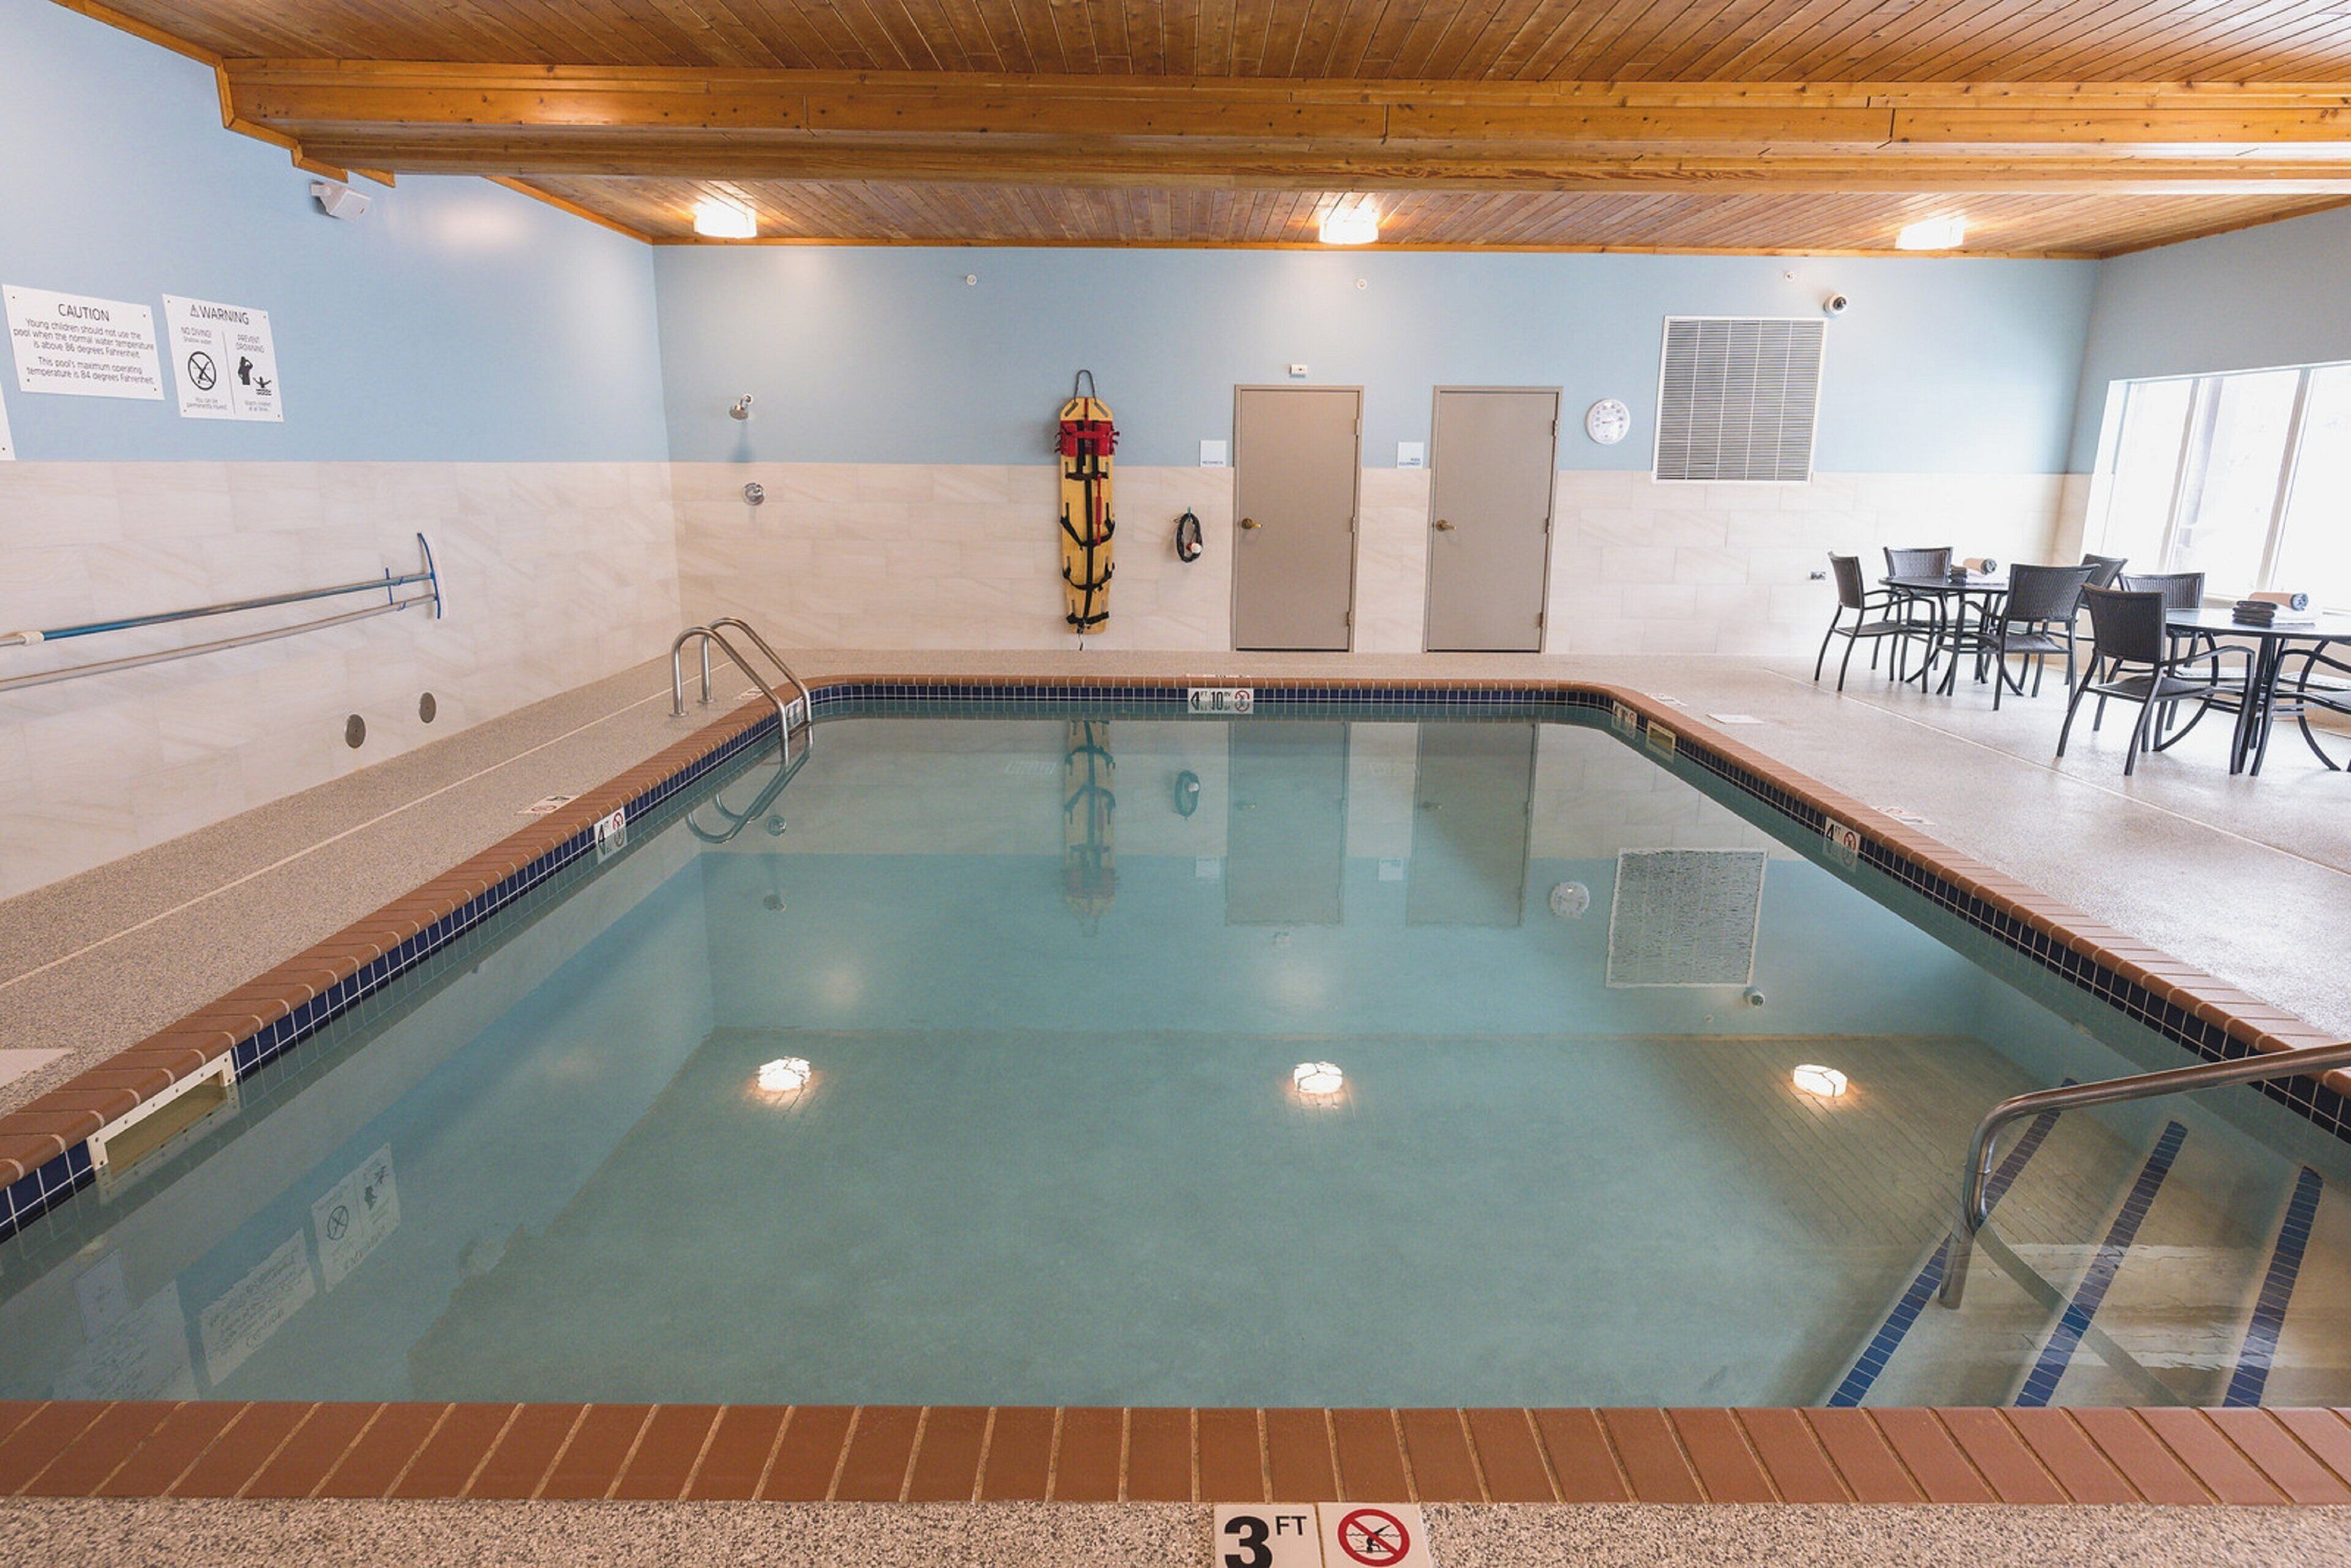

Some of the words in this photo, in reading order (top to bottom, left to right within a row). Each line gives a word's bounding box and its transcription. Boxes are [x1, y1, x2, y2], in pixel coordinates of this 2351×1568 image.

[58, 304, 110, 322] CAUTION
[200, 305, 249, 325] WARNING
[24, 318, 49, 330] Young
[51, 322, 80, 333] children
[81, 326, 104, 336] should
[180, 326, 190, 336] NO
[13, 329, 31, 337] pool
[32, 331, 53, 340] when
[54, 332, 67, 342] the
[69, 334, 94, 345] normal
[95, 337, 113, 346] water
[115, 339, 154, 350] temperature
[33, 340, 40, 348] is
[41, 340, 63, 351] above
[65, 342, 75, 352] 86
[77, 343, 105, 355] degrees
[26, 367, 72, 378] temperature
[92, 372, 119, 382] degrees
[38, 356, 54, 367] This
[77, 361, 110, 371] maximum
[111, 364, 143, 375] operating
[1224, 1516, 1273, 1568] 3
[1275, 1516, 1307, 1535] FT
